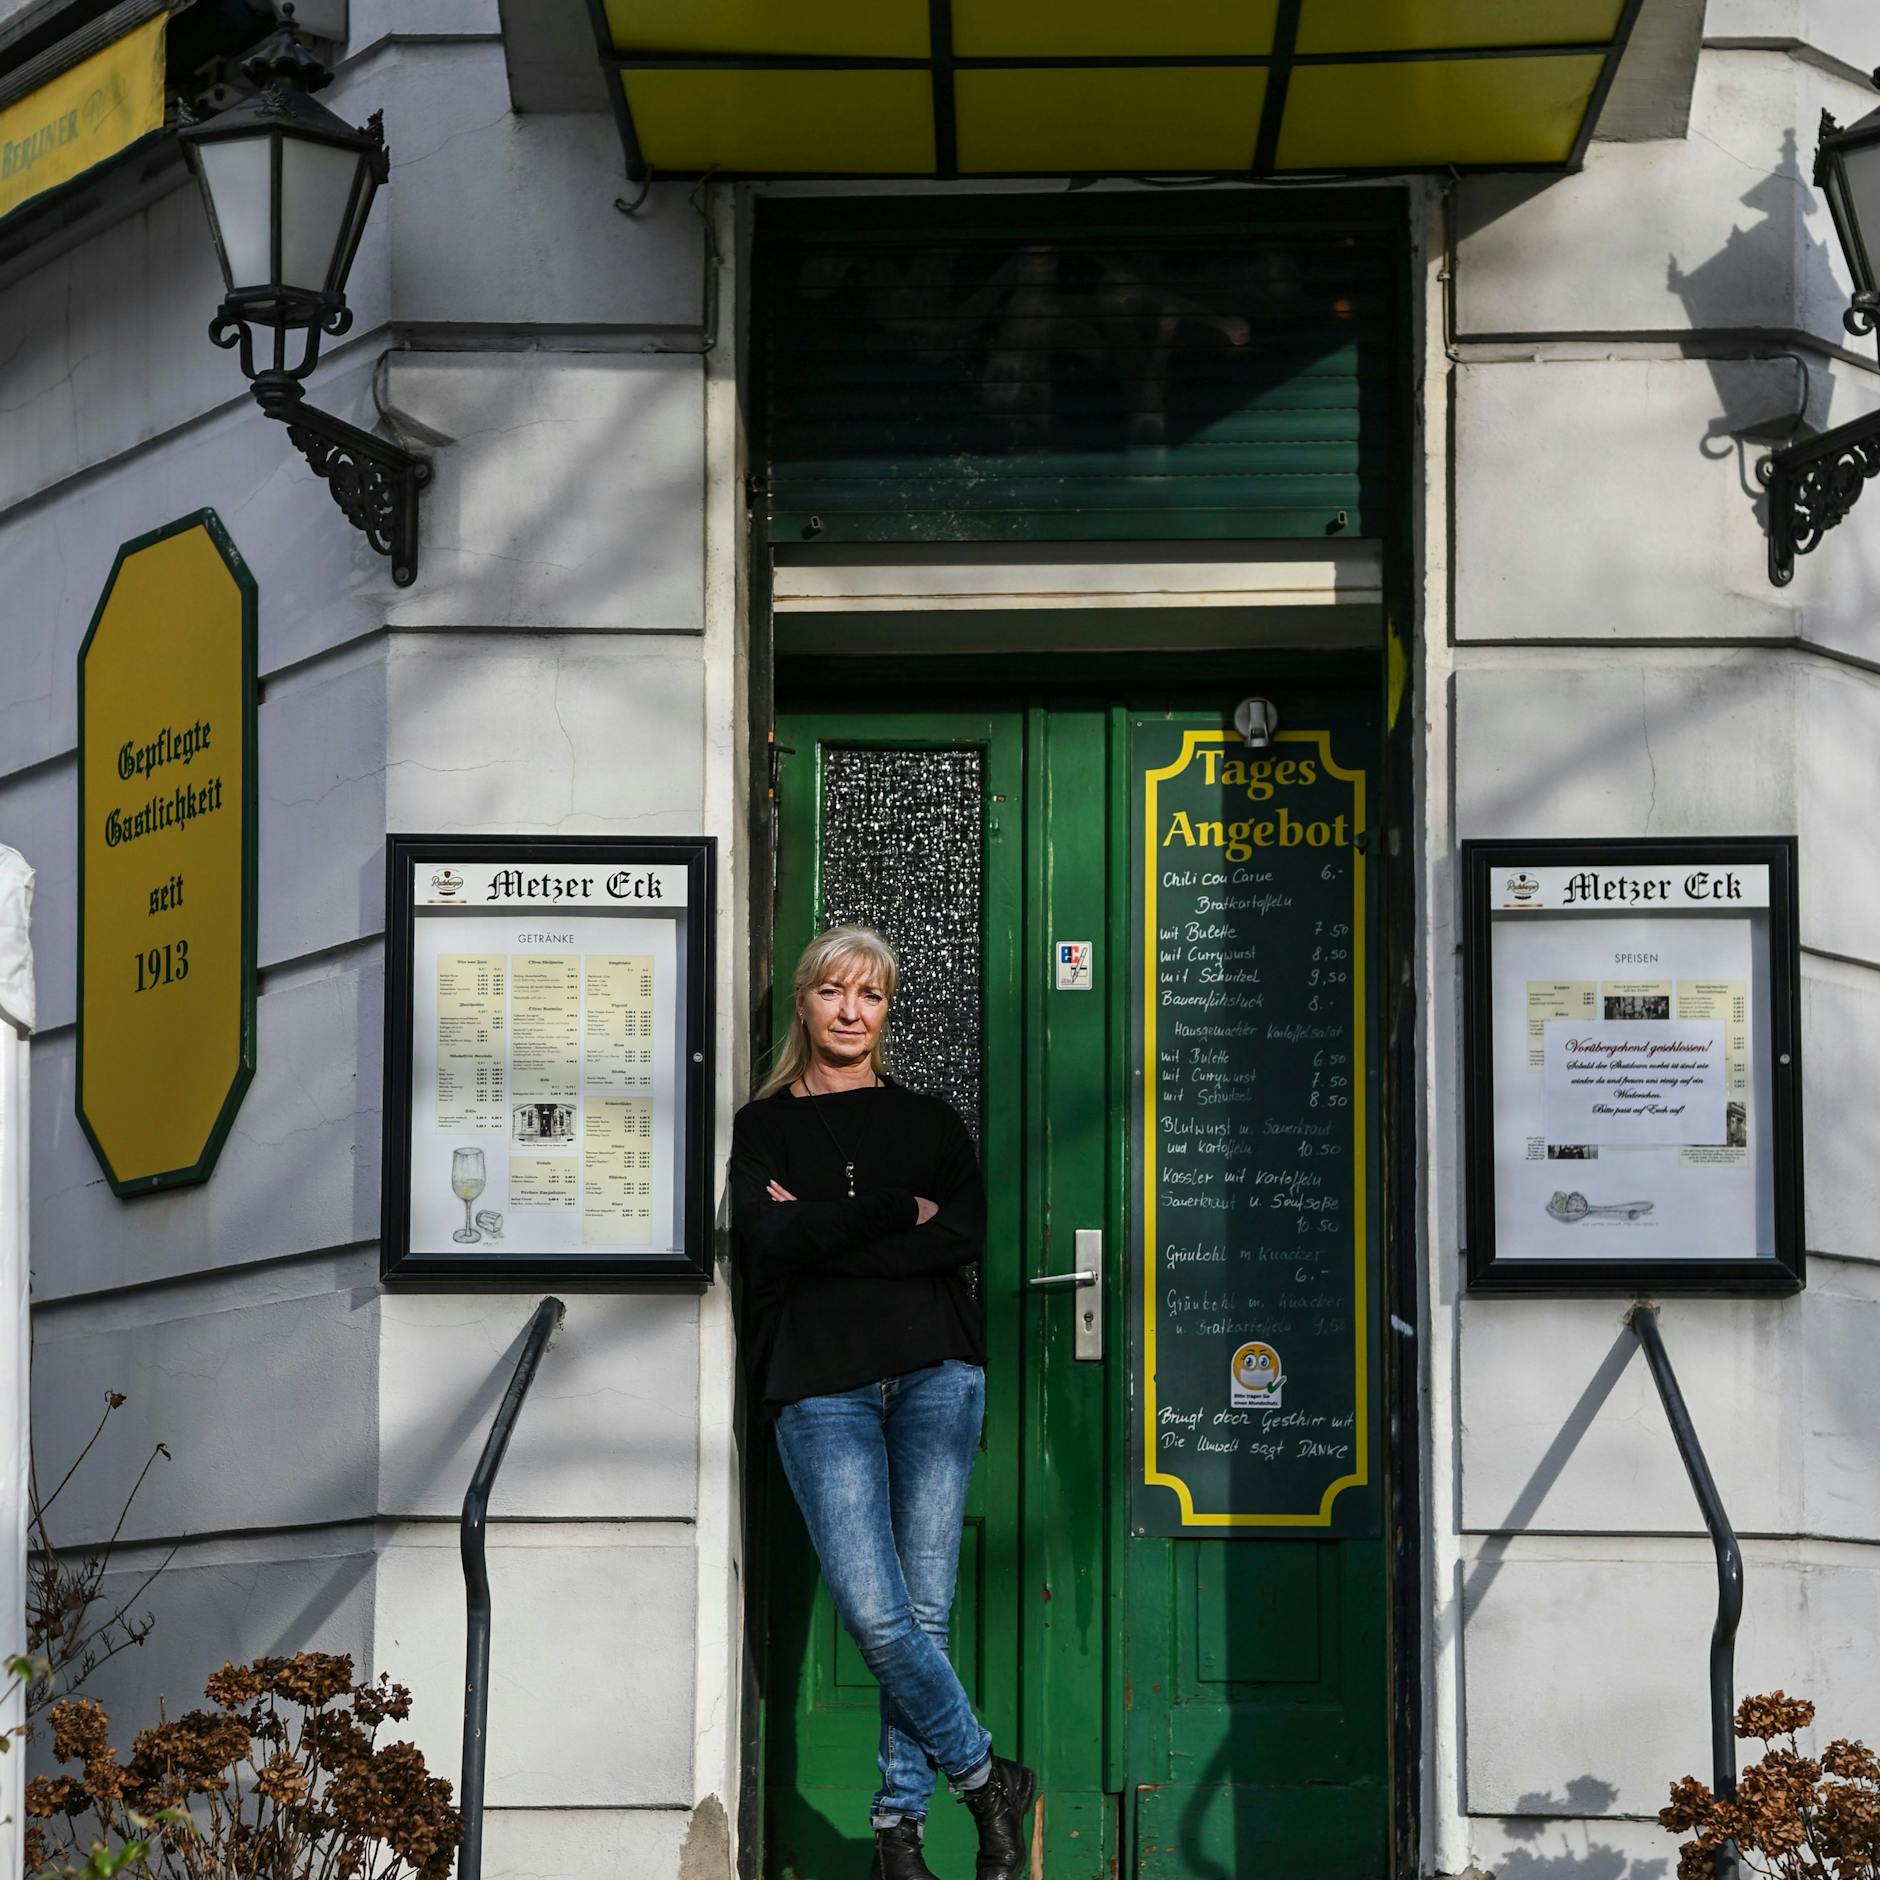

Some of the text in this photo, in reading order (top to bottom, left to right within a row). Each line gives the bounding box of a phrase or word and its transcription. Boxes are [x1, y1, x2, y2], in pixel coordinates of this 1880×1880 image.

[118, 720, 211, 780] Gepflegte
[1196, 749, 1317, 801] Tages
[105, 776, 222, 847] Gastlichkeit
[1162, 808, 1349, 862] Angebot
[486, 869, 663, 903] Metzer Eck
[1162, 869, 1198, 888] Chili
[1563, 872, 1743, 906] Metzer Eck
[148, 873, 184, 916] seit
[1194, 892, 1293, 916] Bratkartoffeln
[518, 932, 575, 944] GETRÄNKE
[1160, 924, 1181, 940] mit
[1184, 921, 1239, 942] Bulette
[135, 939, 189, 993] 1913
[1160, 945, 1182, 962] mit
[1187, 944, 1256, 968] Currywurst
[1615, 953, 1659, 964] SPEISEN
[1161, 968, 1189, 983] mit
[1199, 967, 1261, 983] Schnitzel
[1161, 1048, 1180, 1063] mit
[1188, 1046, 1230, 1064] Bulette
[1565, 1038, 1713, 1058] Vorübergehend geschlossen!
[1566, 1060, 1594, 1071] Sobald
[1595, 1061, 1607, 1070] der
[1680, 1061, 1695, 1070] sind
[1162, 1067, 1181, 1082] mit
[1191, 1067, 1256, 1089] Currywurst
[1571, 1076, 1594, 1085] wieder
[1595, 1076, 1606, 1085] da
[1607, 1076, 1622, 1085] und
[1680, 1076, 1694, 1087] auf
[1163, 1087, 1184, 1102] mit
[1592, 1104, 1615, 1115] Bitte
[1633, 1104, 1645, 1116] auf
[1161, 1115, 1232, 1136] Blutwurst
[1167, 1141, 1188, 1154] und
[1198, 1138, 1252, 1160] Kartoffeln
[1161, 1166, 1322, 1197] Kassler mit Kartoffeln
[1161, 1190, 1236, 1210] Sauerkraut
[1157, 1405, 1204, 1431] Bringt
[1212, 1408, 1252, 1425] doch
[1261, 1408, 1328, 1435] Geschirr
[1160, 1431, 1186, 1449] Die
[1196, 1435, 1240, 1453] Umwelt
[1249, 1440, 1285, 1461] sagt
